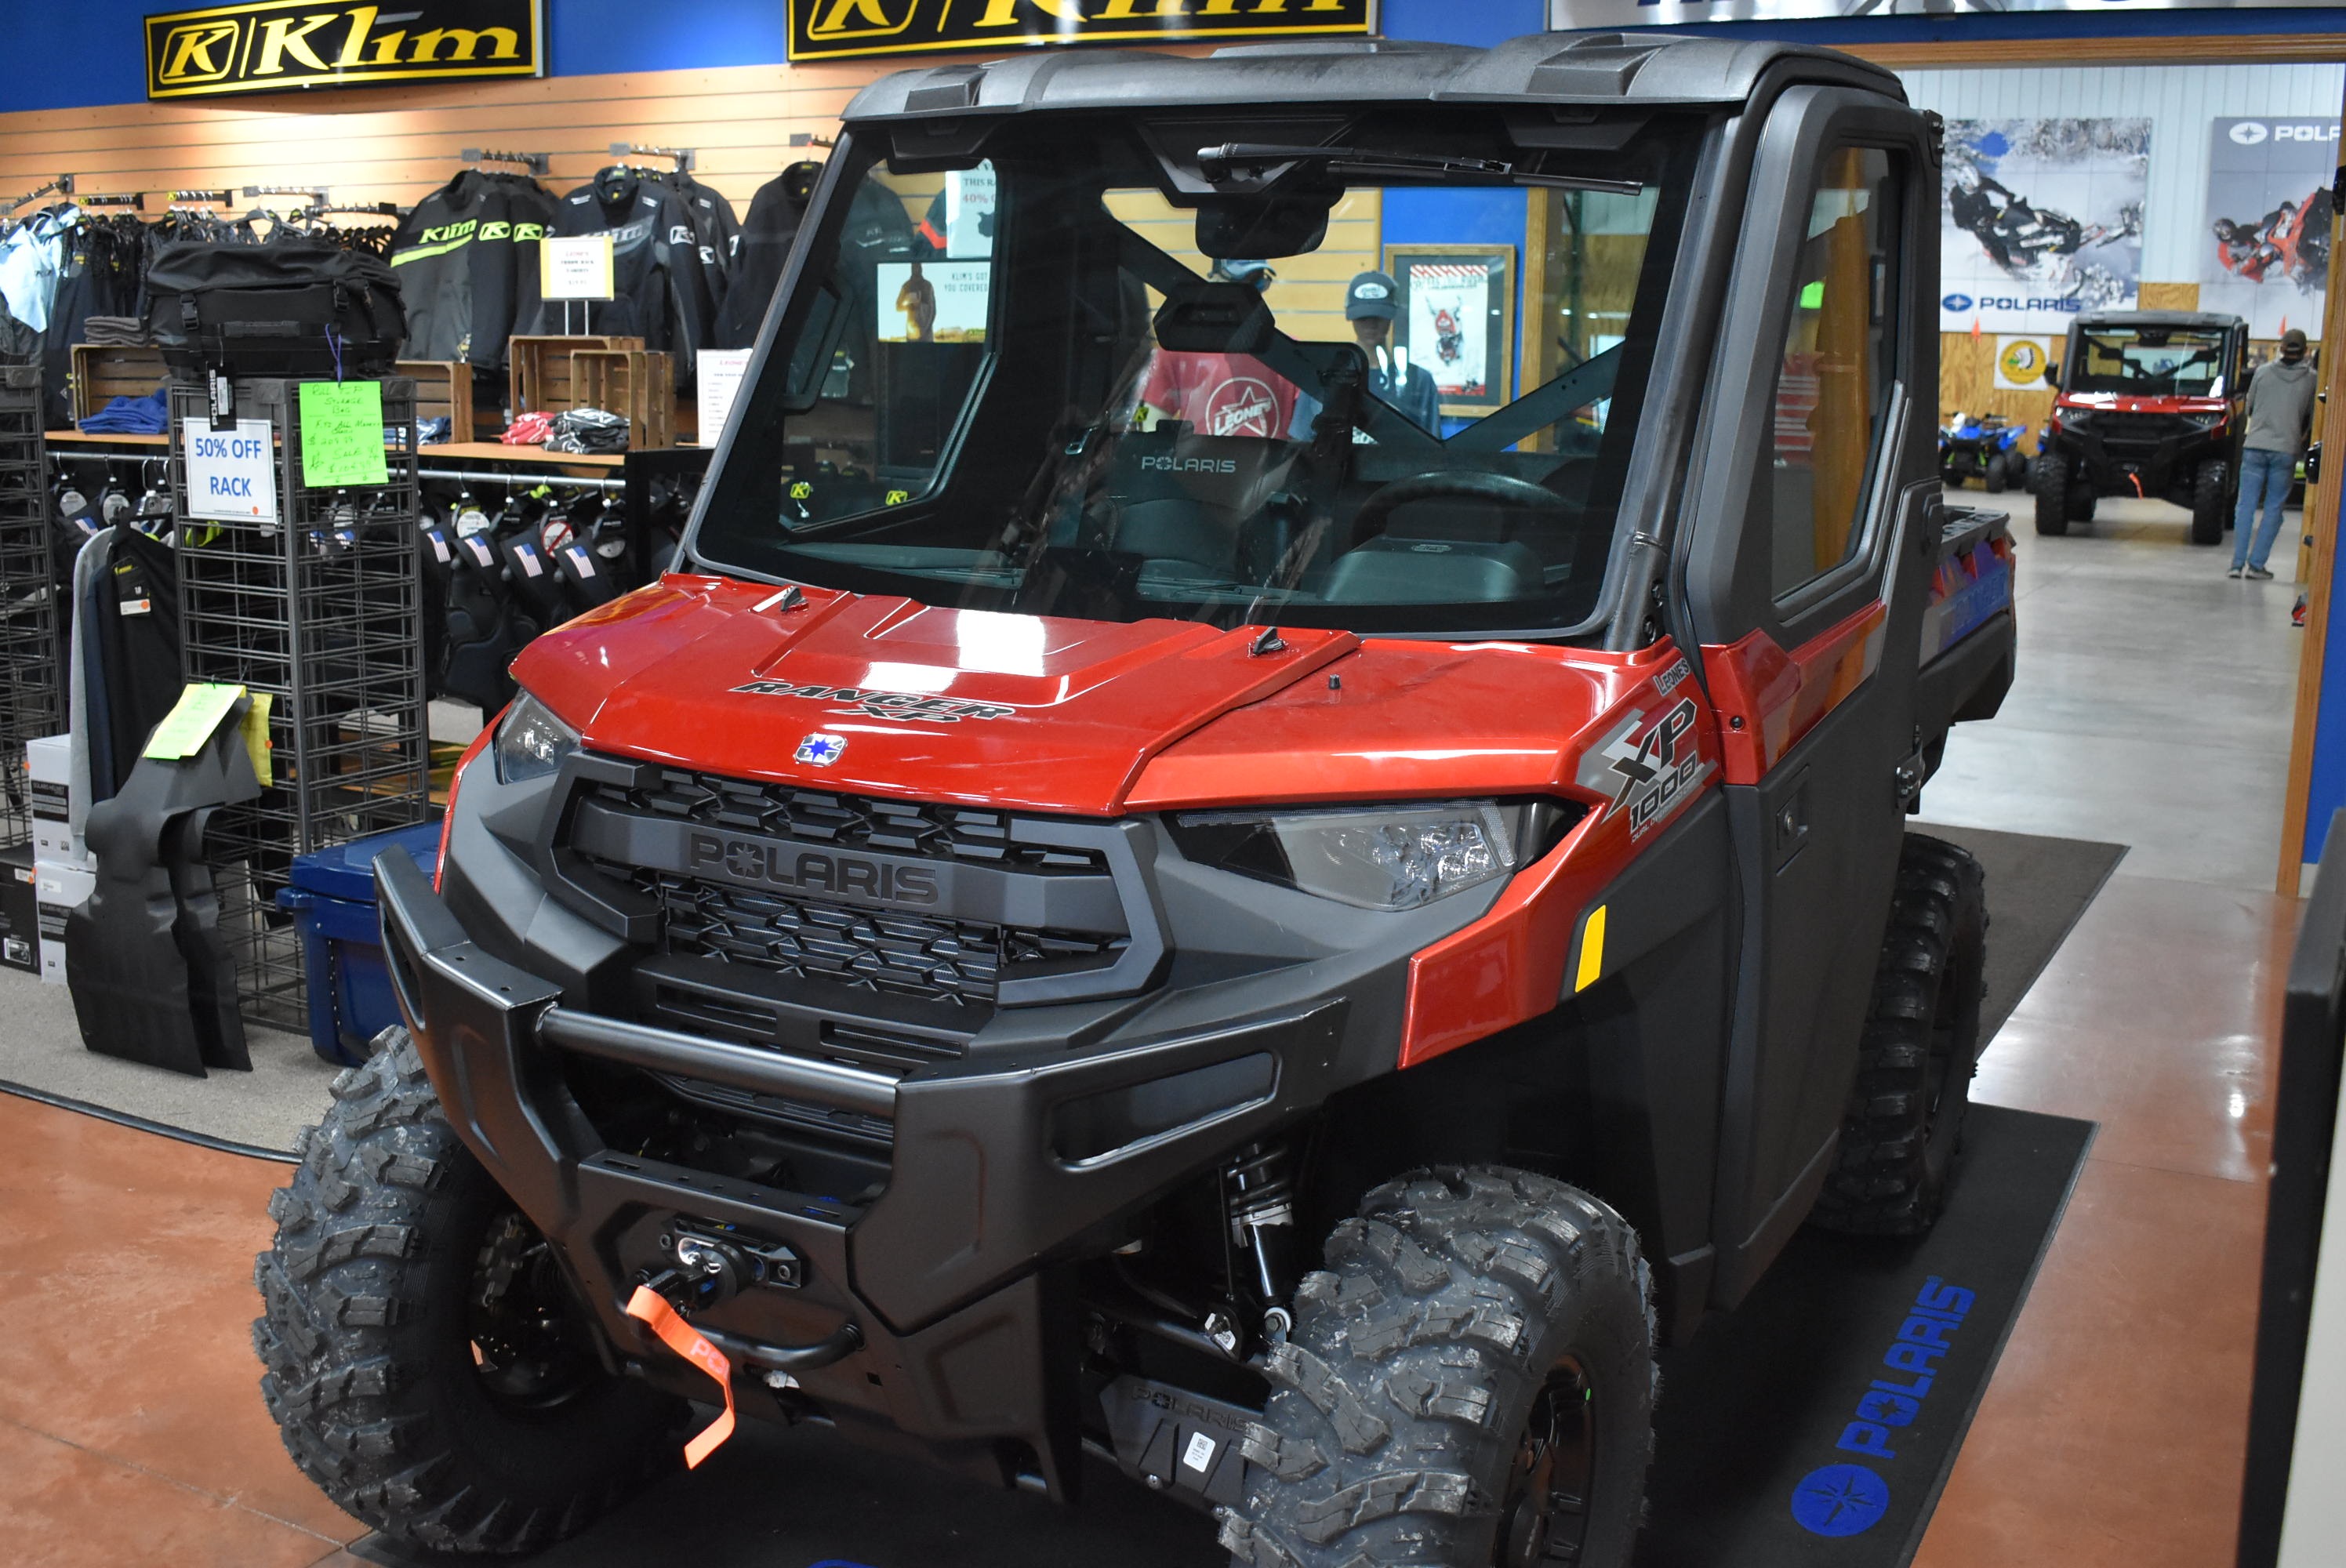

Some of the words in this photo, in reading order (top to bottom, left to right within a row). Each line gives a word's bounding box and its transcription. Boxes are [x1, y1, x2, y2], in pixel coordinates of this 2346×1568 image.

[163, 27, 234, 77] K
[252, 5, 520, 74] Klim
[1980, 297, 2081, 312] POLARIS
[209, 369, 219, 426] POLARIS
[195, 437, 227, 458] 50%
[231, 439, 261, 459] OFF
[1141, 456, 1236, 473] POLARIS
[209, 476, 251, 497] RACK
[1653, 658, 1690, 697] LEONE'S
[728, 681, 1016, 720] RANGER
[822, 703, 961, 722] XP
[1601, 696, 1698, 825] XP
[1629, 750, 1697, 835] 1000
[690, 833, 939, 906] POLARIS
[1836, 1279, 1976, 1460] POLARIS
[1131, 1385, 1248, 1432] POLARIS
